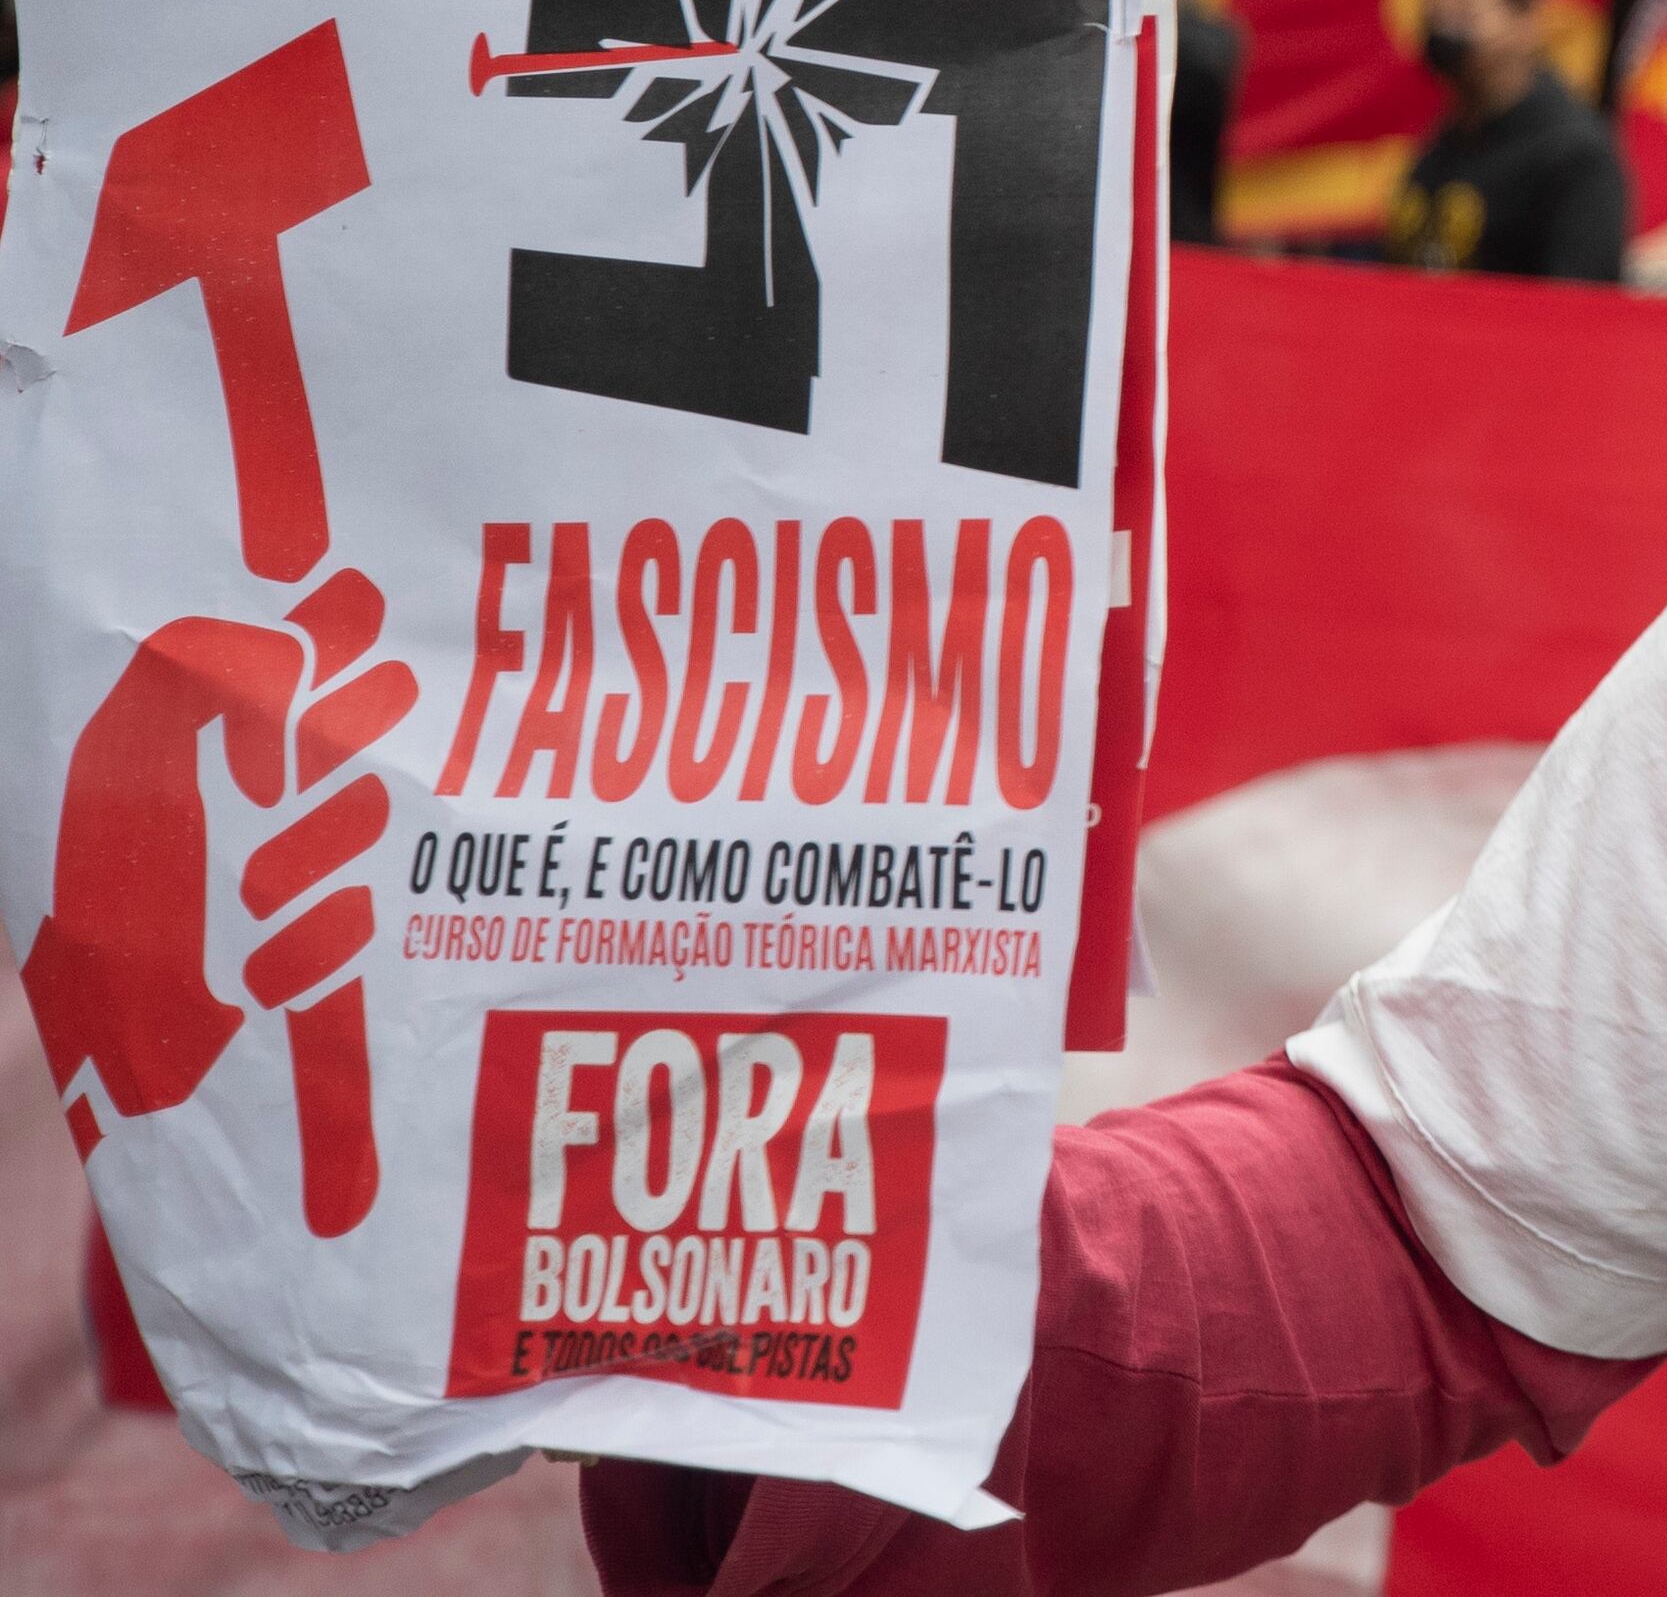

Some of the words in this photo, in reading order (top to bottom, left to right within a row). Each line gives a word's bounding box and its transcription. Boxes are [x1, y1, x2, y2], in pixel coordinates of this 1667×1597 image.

[434, 515, 1074, 811] FASCISMO
[410, 831, 438, 894] O
[448, 832, 530, 904] QUE
[539, 819, 571, 910] É,
[584, 836, 614, 899] E
[622, 837, 751, 903] COMO
[764, 831, 1047, 913] COMBATÊ-LO
[402, 913, 506, 961] CURSO
[510, 916, 550, 963] DE
[555, 911, 734, 982] FORMAÇÃO
[743, 912, 875, 971] TEÓRICA
[886, 926, 1041, 977] MARXISTA
[527, 1029, 877, 1236] FORA
[519, 1233, 872, 1328] BOLSONARO
[511, 1330, 534, 1376] E
[691, 1330, 857, 1383] LPISTAS
